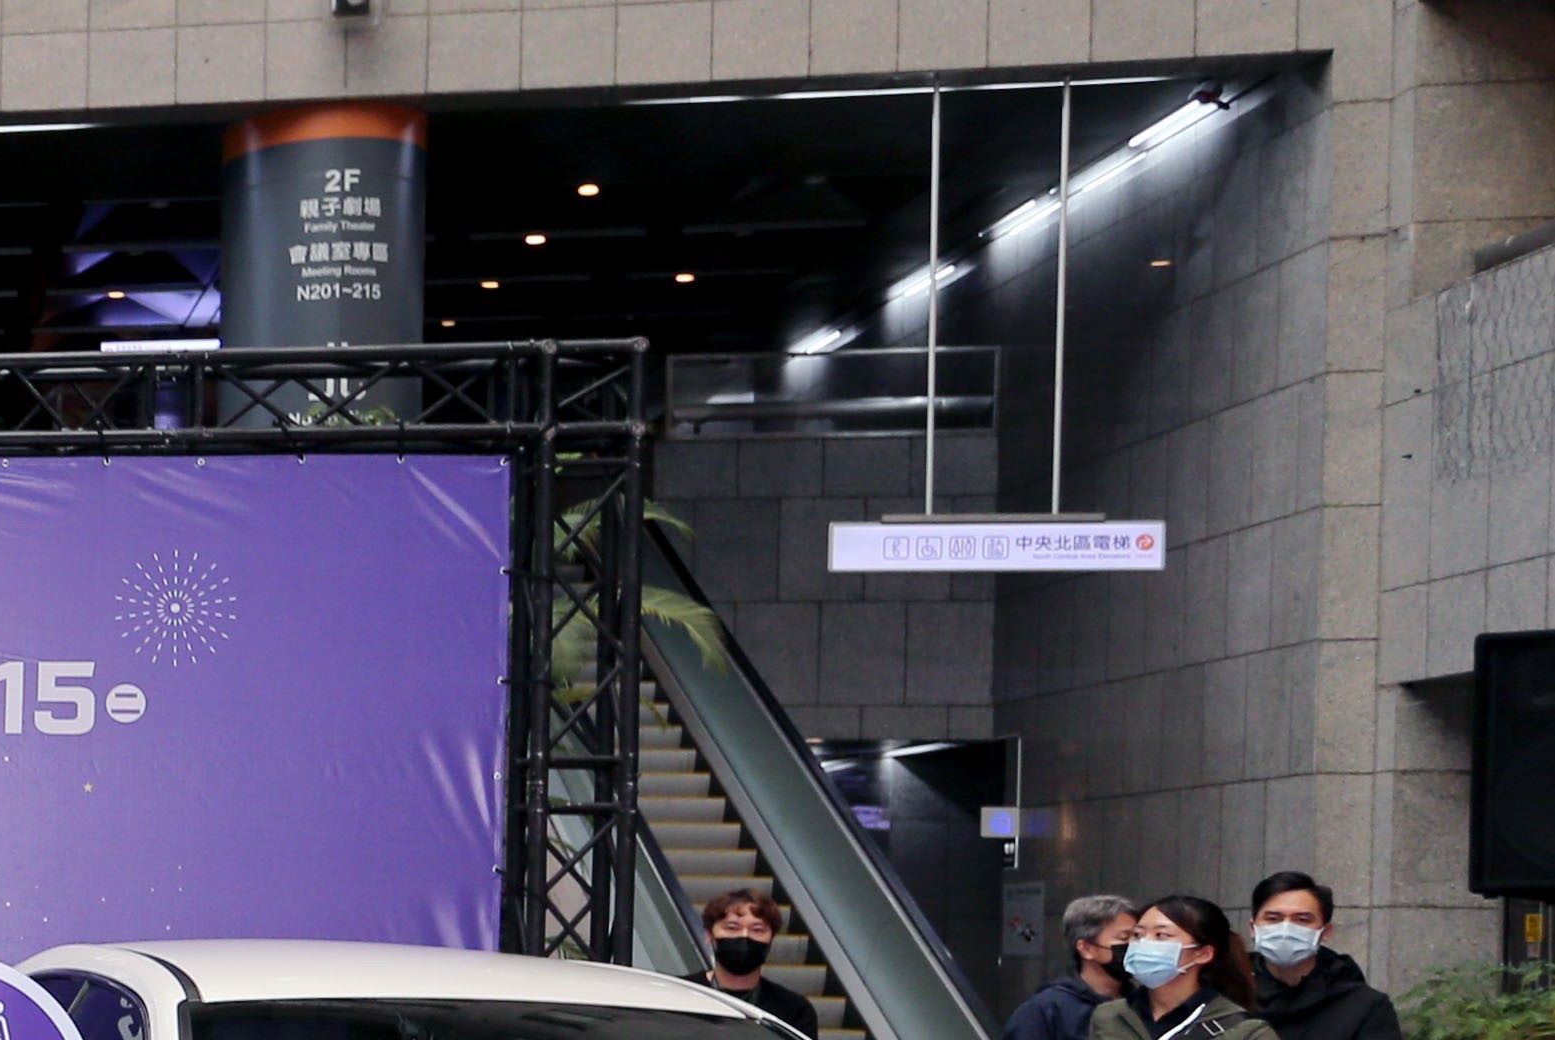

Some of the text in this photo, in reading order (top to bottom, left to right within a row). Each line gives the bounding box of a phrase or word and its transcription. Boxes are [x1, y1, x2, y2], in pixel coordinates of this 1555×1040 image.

[324, 168, 361, 192] 2F
[299, 196, 381, 219] 親子劇場
[304, 221, 338, 233] Family
[289, 241, 388, 264] 會議室專區
[302, 265, 376, 277] Meeting Rooms
[1015, 534, 1130, 550] 中央北區電梯
